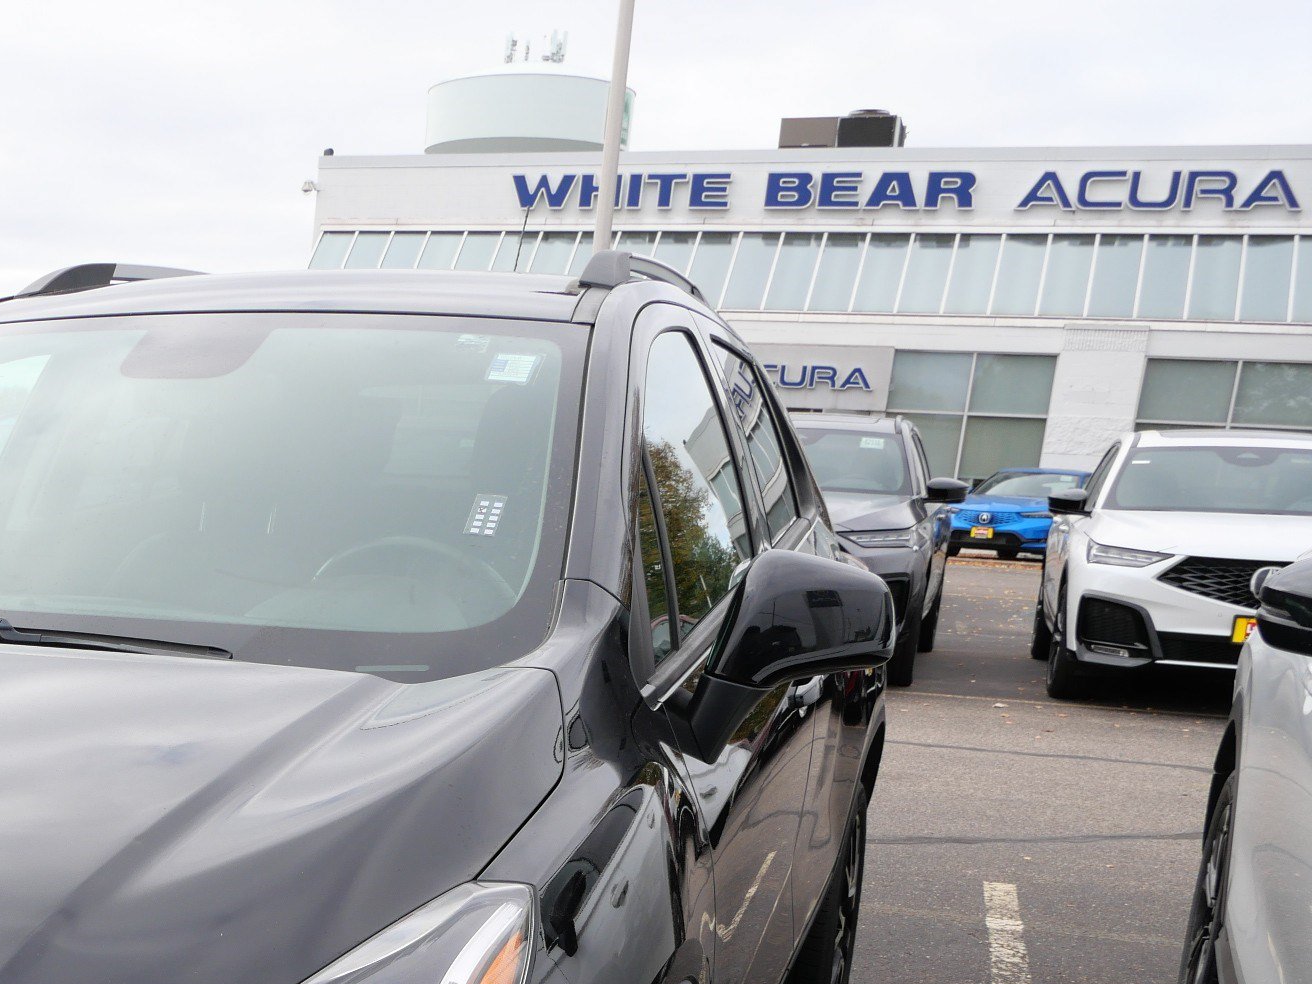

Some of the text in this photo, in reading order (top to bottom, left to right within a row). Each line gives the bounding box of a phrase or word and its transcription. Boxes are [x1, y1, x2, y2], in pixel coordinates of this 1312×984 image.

[512, 169, 1303, 212] WHITE BEAR ACURA
